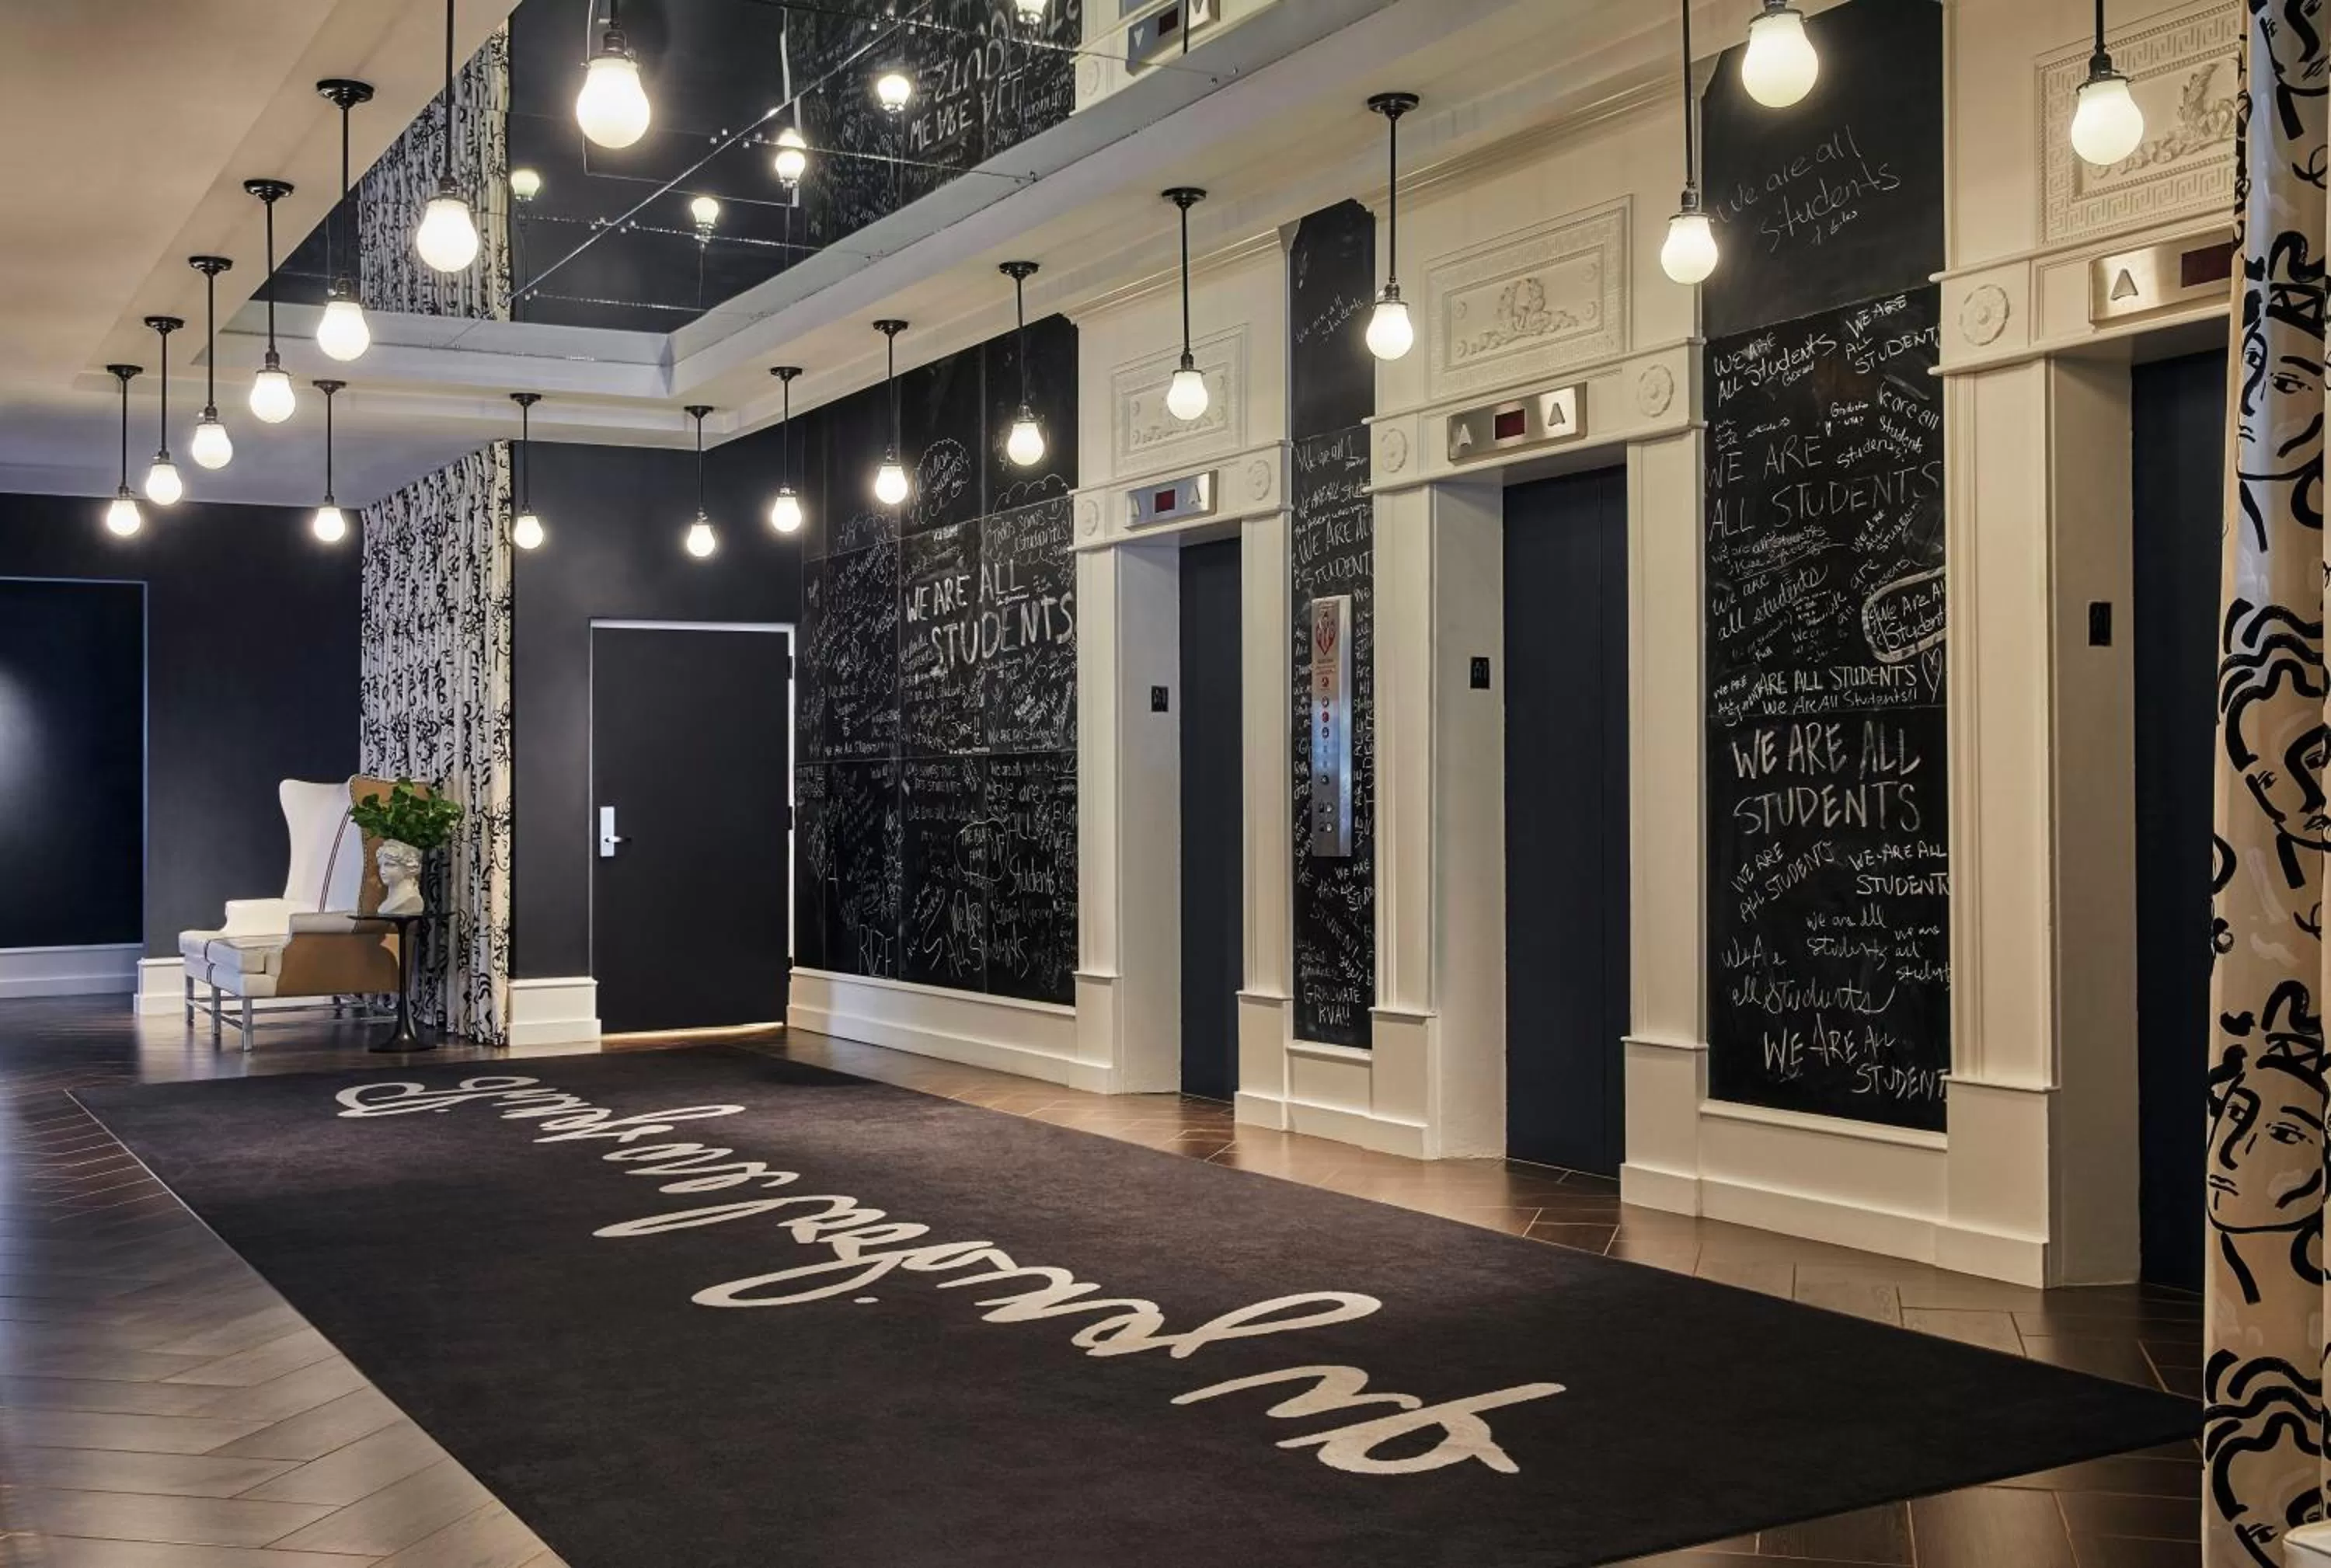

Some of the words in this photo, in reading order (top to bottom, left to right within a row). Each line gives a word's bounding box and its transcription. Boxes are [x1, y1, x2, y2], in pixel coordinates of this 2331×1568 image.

[1763, 434, 1823, 481] ARE
[1709, 497, 1756, 542] ALL
[1772, 460, 1942, 528] STUDENTS
[905, 586, 930, 622] WE
[933, 575, 970, 616] ARE
[979, 559, 1026, 604] ALL
[1301, 550, 1373, 584] STUDENT
[932, 591, 1074, 671] STUDENTS
[1885, 605, 1945, 649] Student
[1829, 664, 1918, 691] STUDENTS
[1731, 728, 1777, 779] WE
[1788, 722, 1847, 775] ARE
[1859, 720, 1922, 780] ALL
[1733, 780, 1921, 835] STUDENTS
[1764, 1027, 1803, 1074] WE
[1809, 1012, 1859, 1067] ARE
[1852, 1063, 1950, 1100] STUDENT
